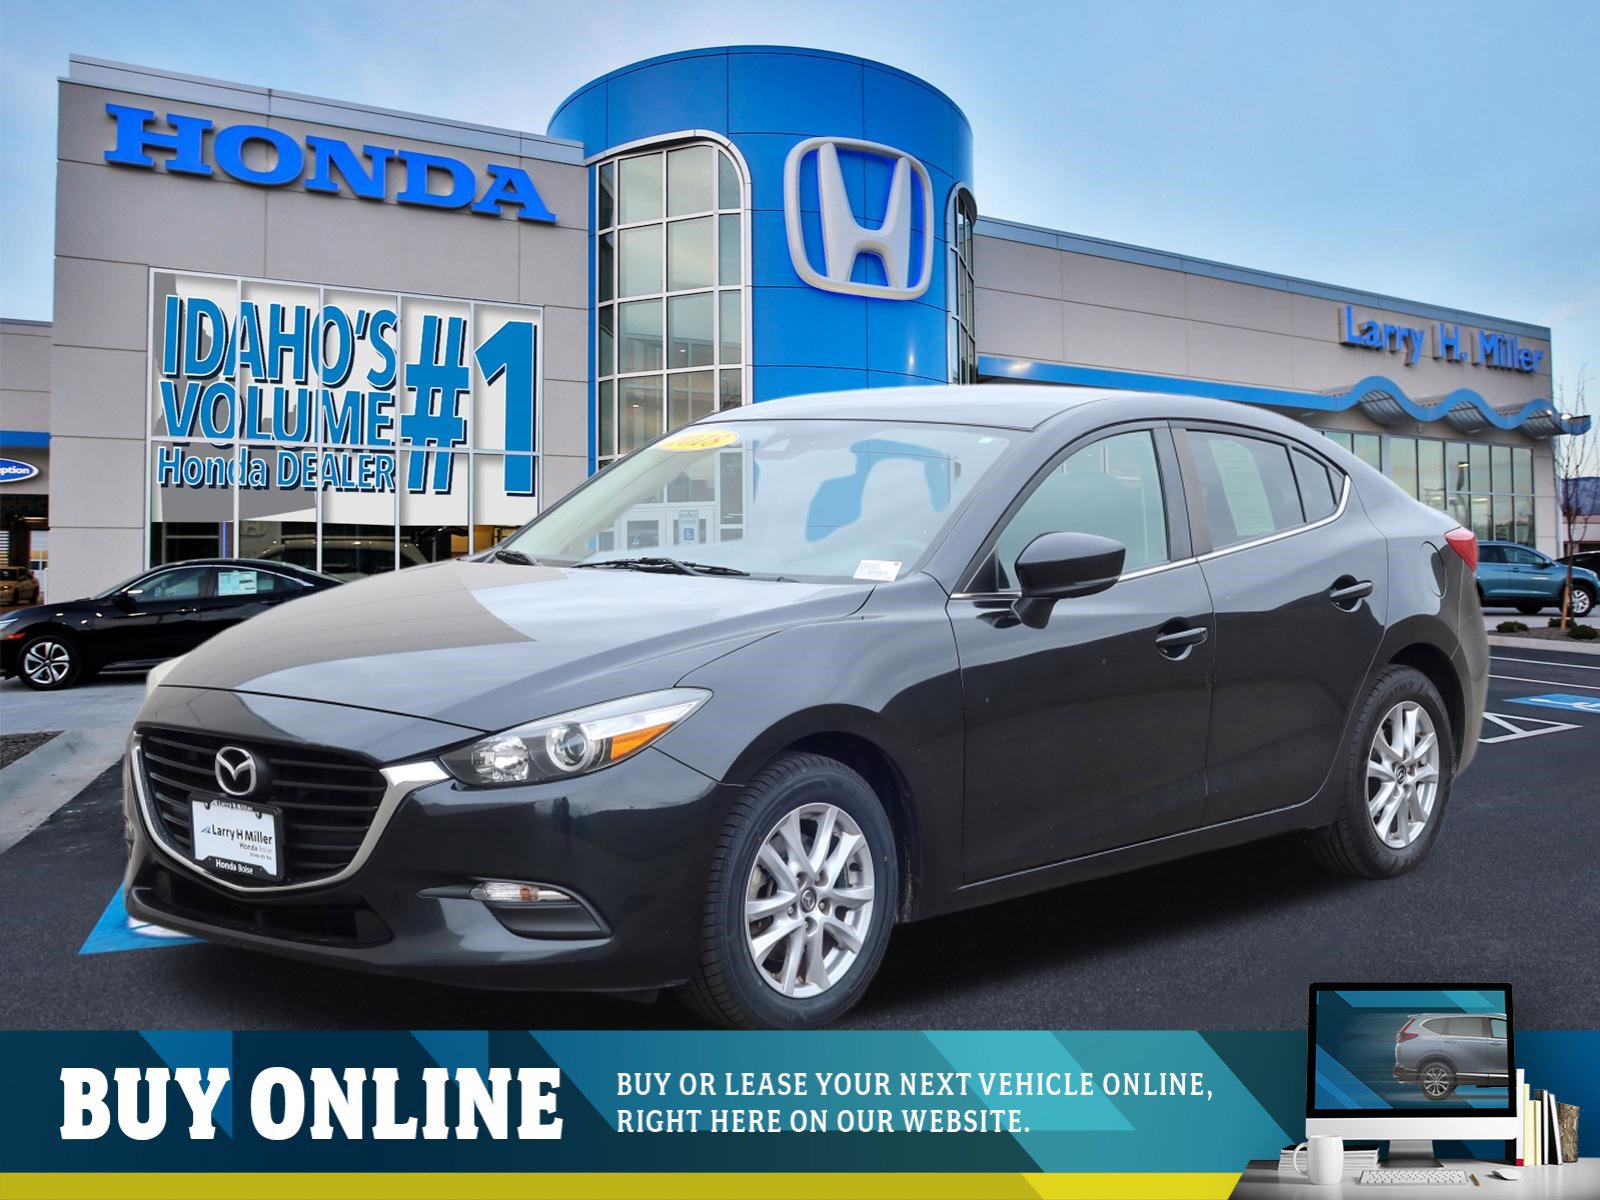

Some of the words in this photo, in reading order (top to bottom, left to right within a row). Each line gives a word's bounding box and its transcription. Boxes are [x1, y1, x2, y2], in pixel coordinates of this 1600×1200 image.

[104, 102, 558, 224] HONDA
[162, 294, 399, 388] IDAHO'S
[1341, 304, 1425, 367] Larry
[1436, 322, 1469, 363] H.
[1475, 330, 1545, 373] Miller
[159, 380, 397, 450] VOLUME
[400, 314, 538, 496] #1
[0, 465, 30, 477] ption
[157, 446, 271, 489] Honda
[275, 450, 396, 493] DEALER
[212, 823, 235, 841] Larry
[236, 828, 244, 840] H
[245, 830, 273, 845] Miller
[215, 858, 237, 872] Honda
[237, 863, 254, 875] Boise
